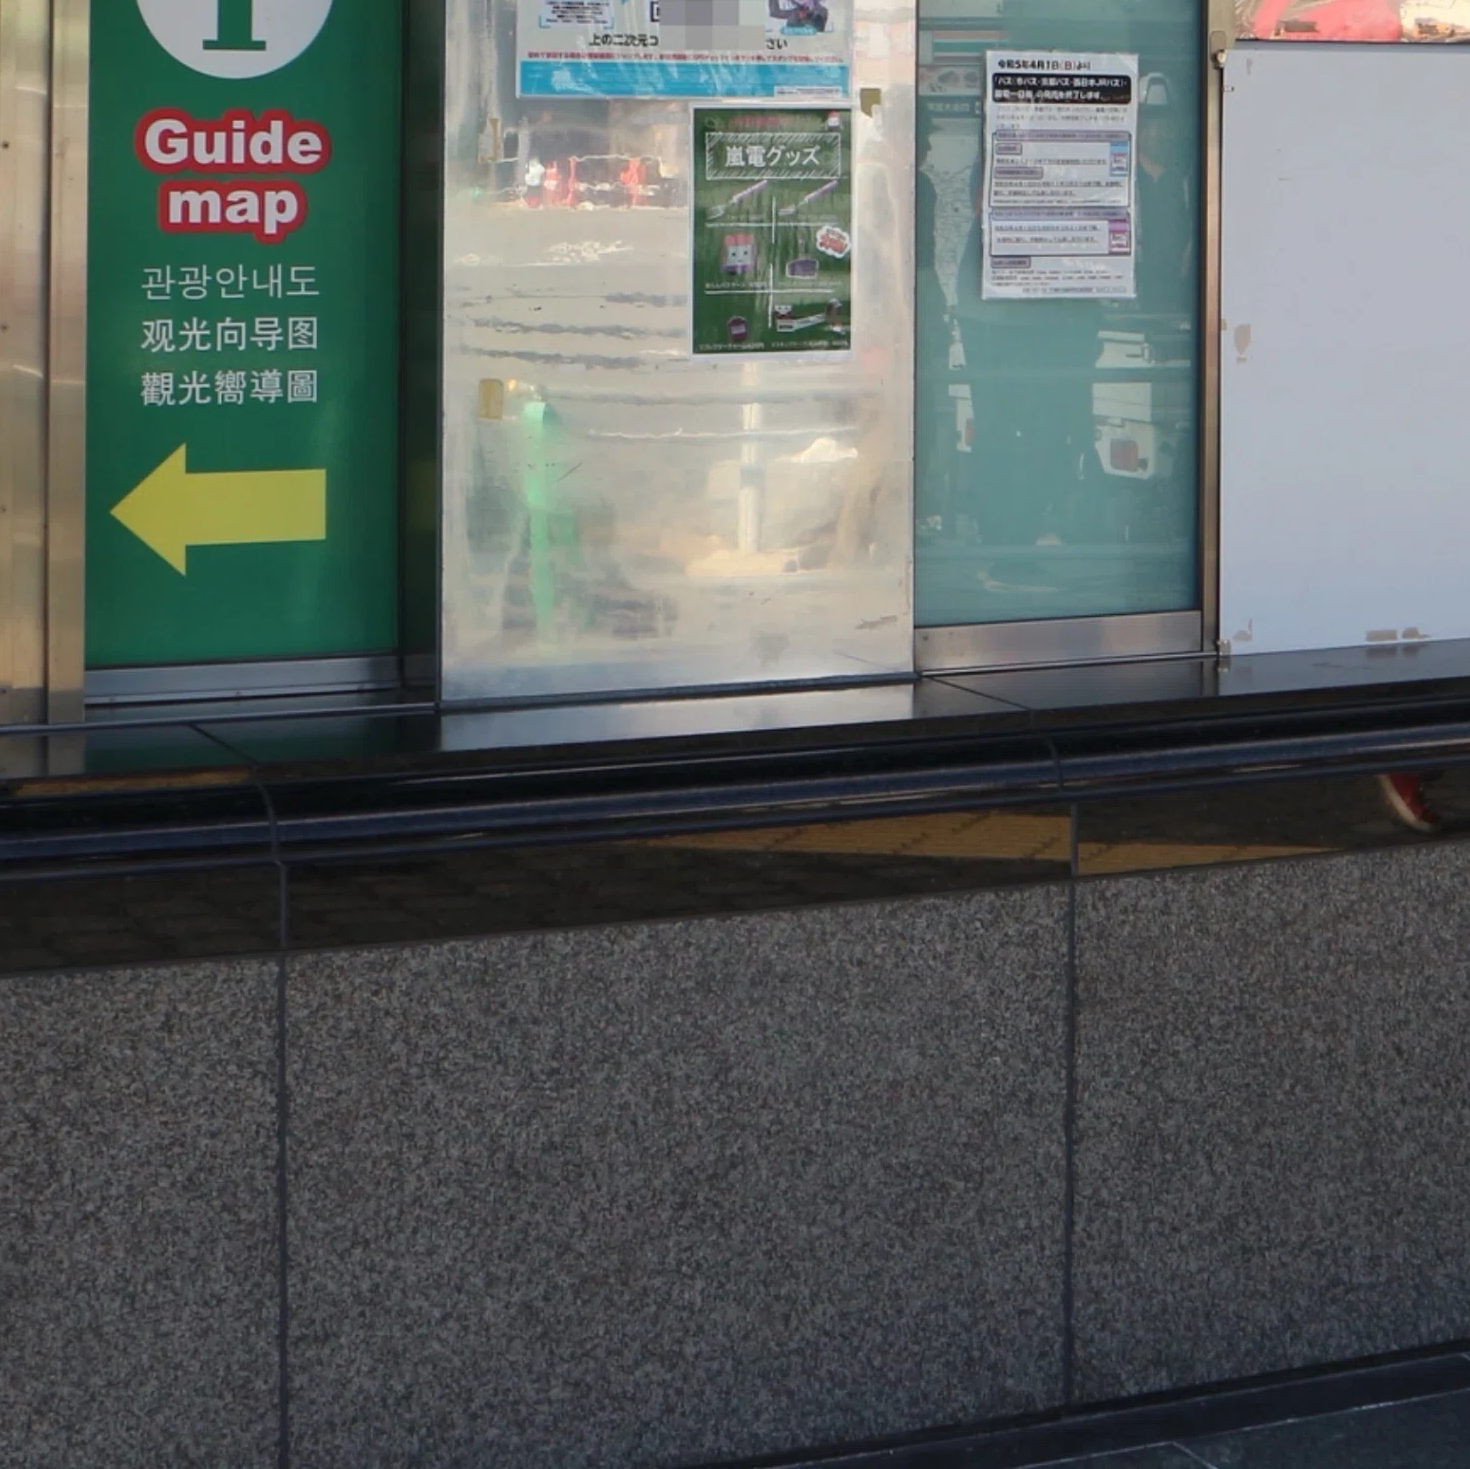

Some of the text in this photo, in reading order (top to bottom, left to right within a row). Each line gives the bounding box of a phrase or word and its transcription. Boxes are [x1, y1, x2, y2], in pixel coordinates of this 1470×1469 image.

[144, 118, 323, 166] Guide
[724, 145, 819, 168] 嵐電グッズ
[168, 186, 298, 234] map
[141, 264, 320, 300] 관광안내도
[141, 318, 319, 352] 观光向导图
